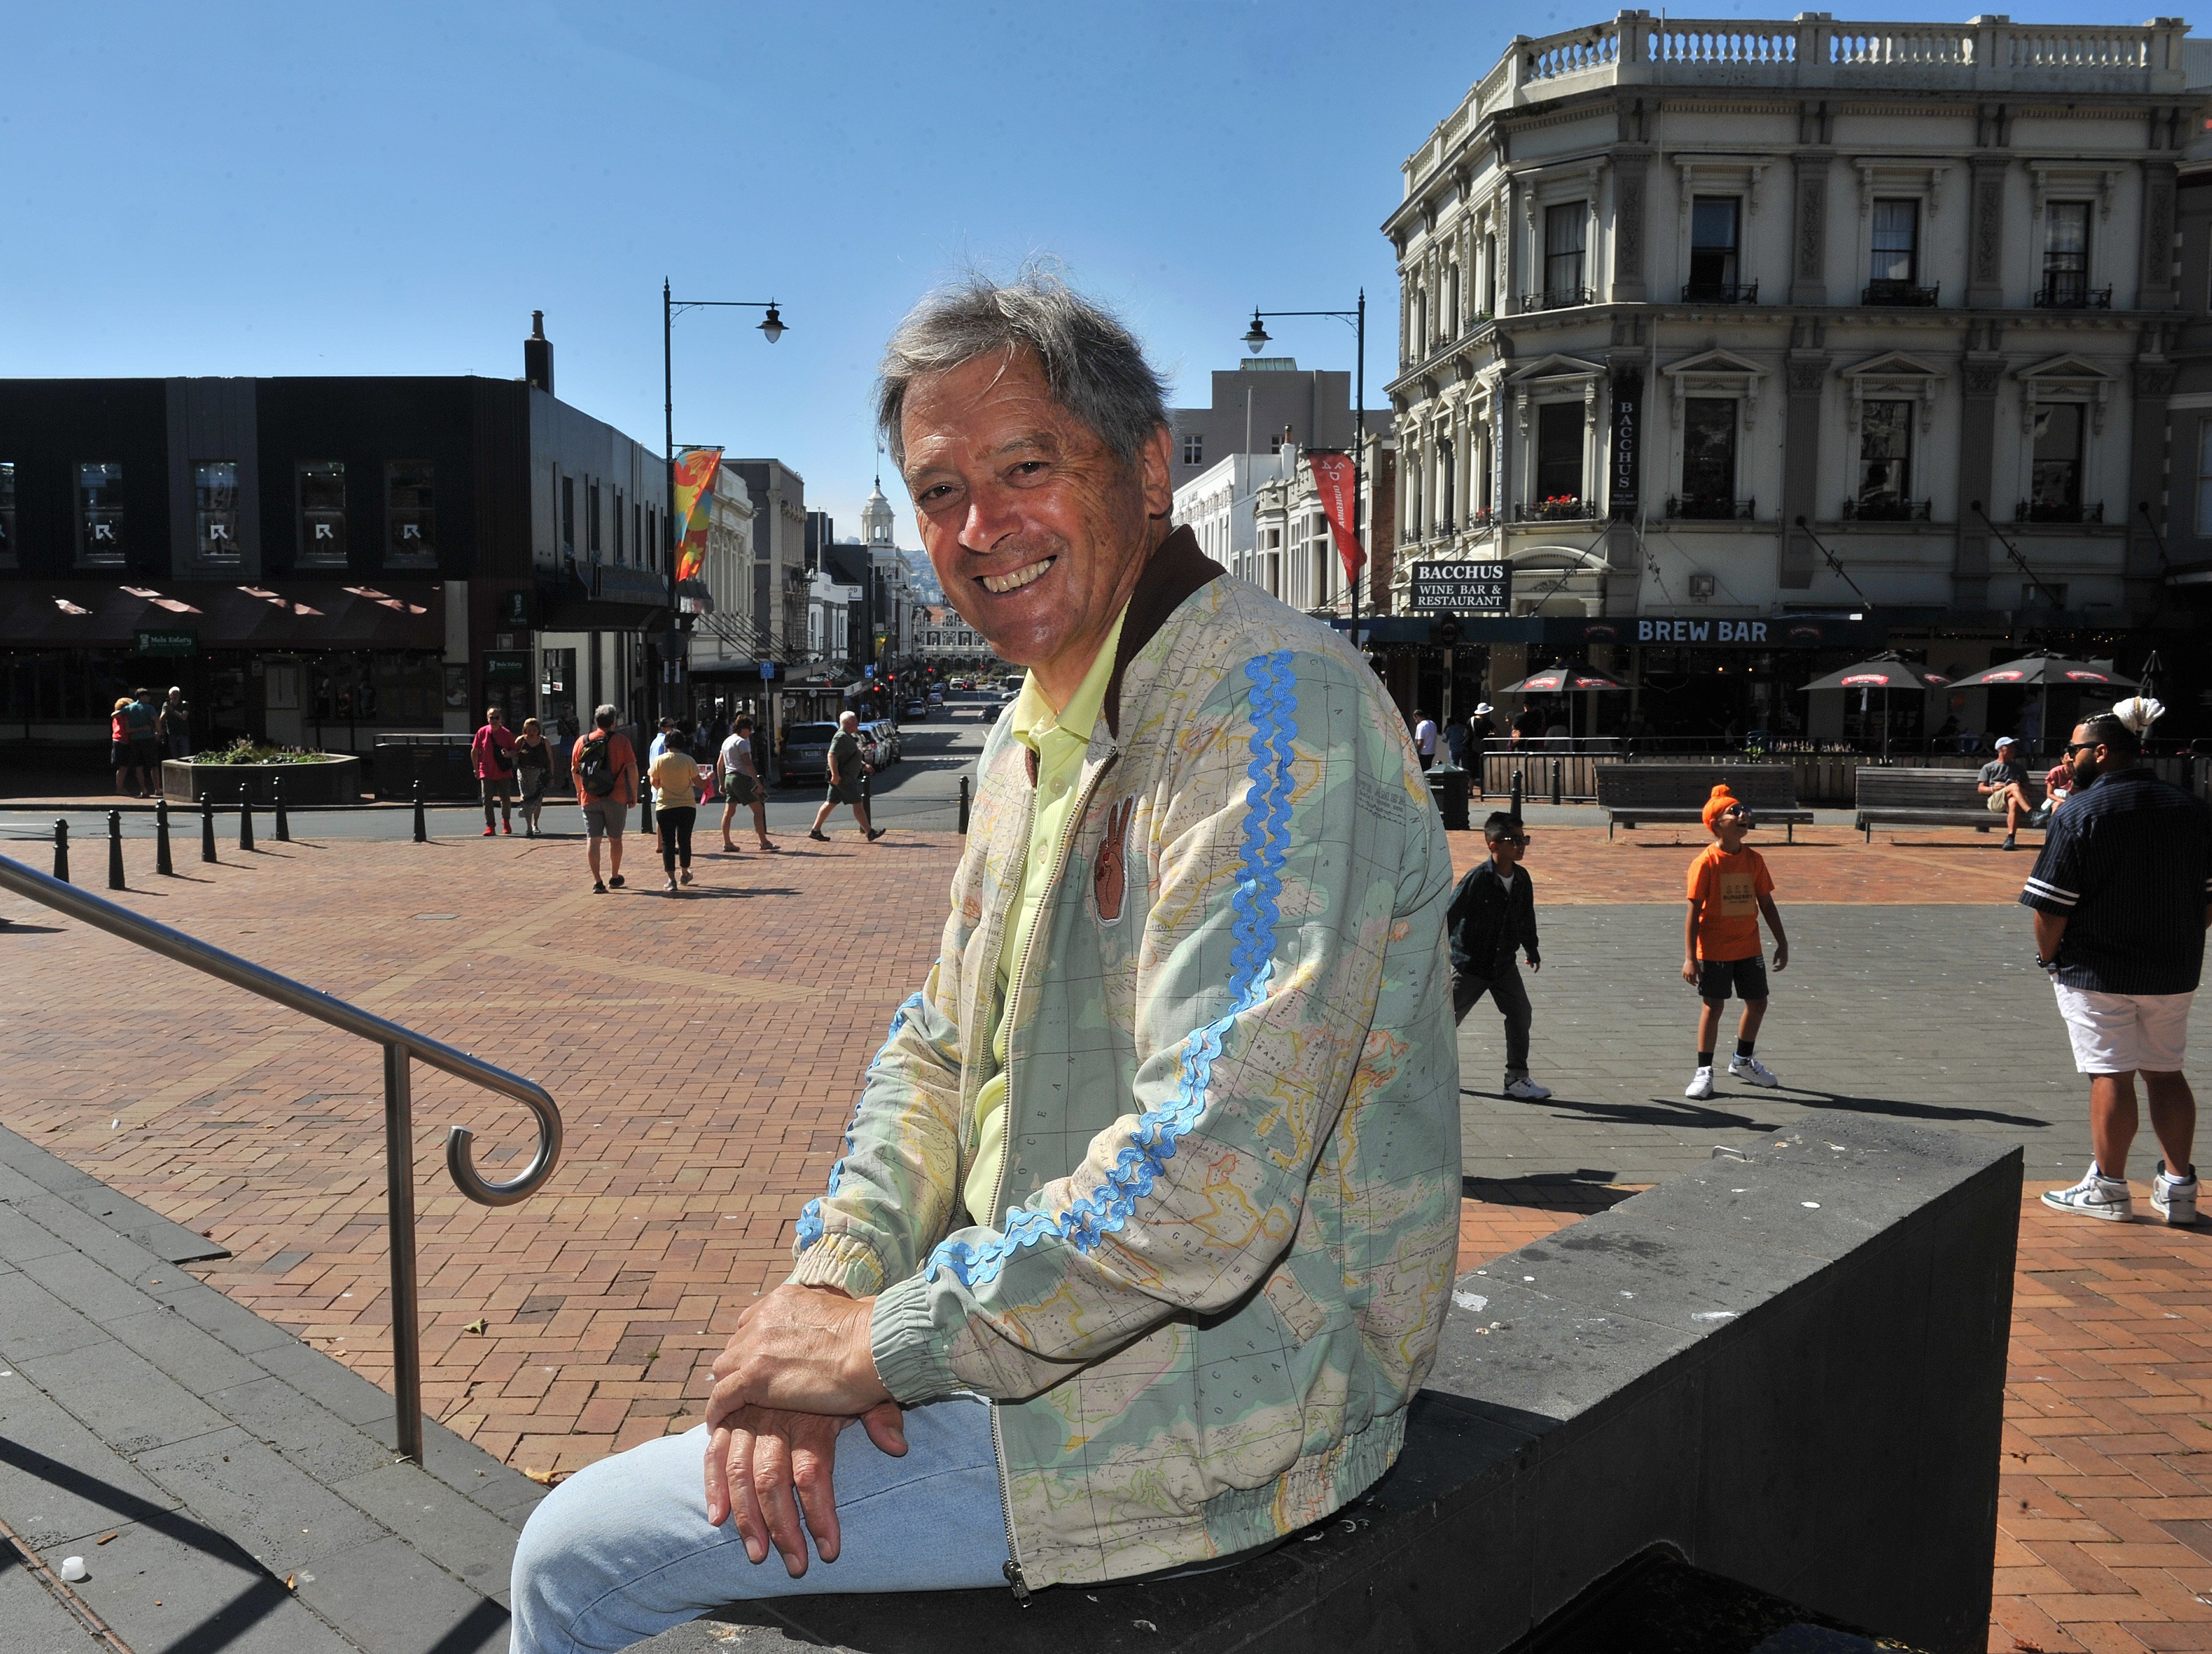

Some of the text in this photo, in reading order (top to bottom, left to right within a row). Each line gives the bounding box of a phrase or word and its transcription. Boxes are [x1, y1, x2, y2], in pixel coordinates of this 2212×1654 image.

[1618, 402, 1633, 488] BACCHUS
[1418, 565, 1504, 580] BACCHUS
[1419, 585, 1501, 595] WINE BAR &
[1418, 595, 1503, 607] RESTAURANT
[1639, 621, 1768, 642] BREW BAR
[1171, 1231, 1224, 1264] GREAT
[1215, 1343, 1299, 1415] OCEAN
